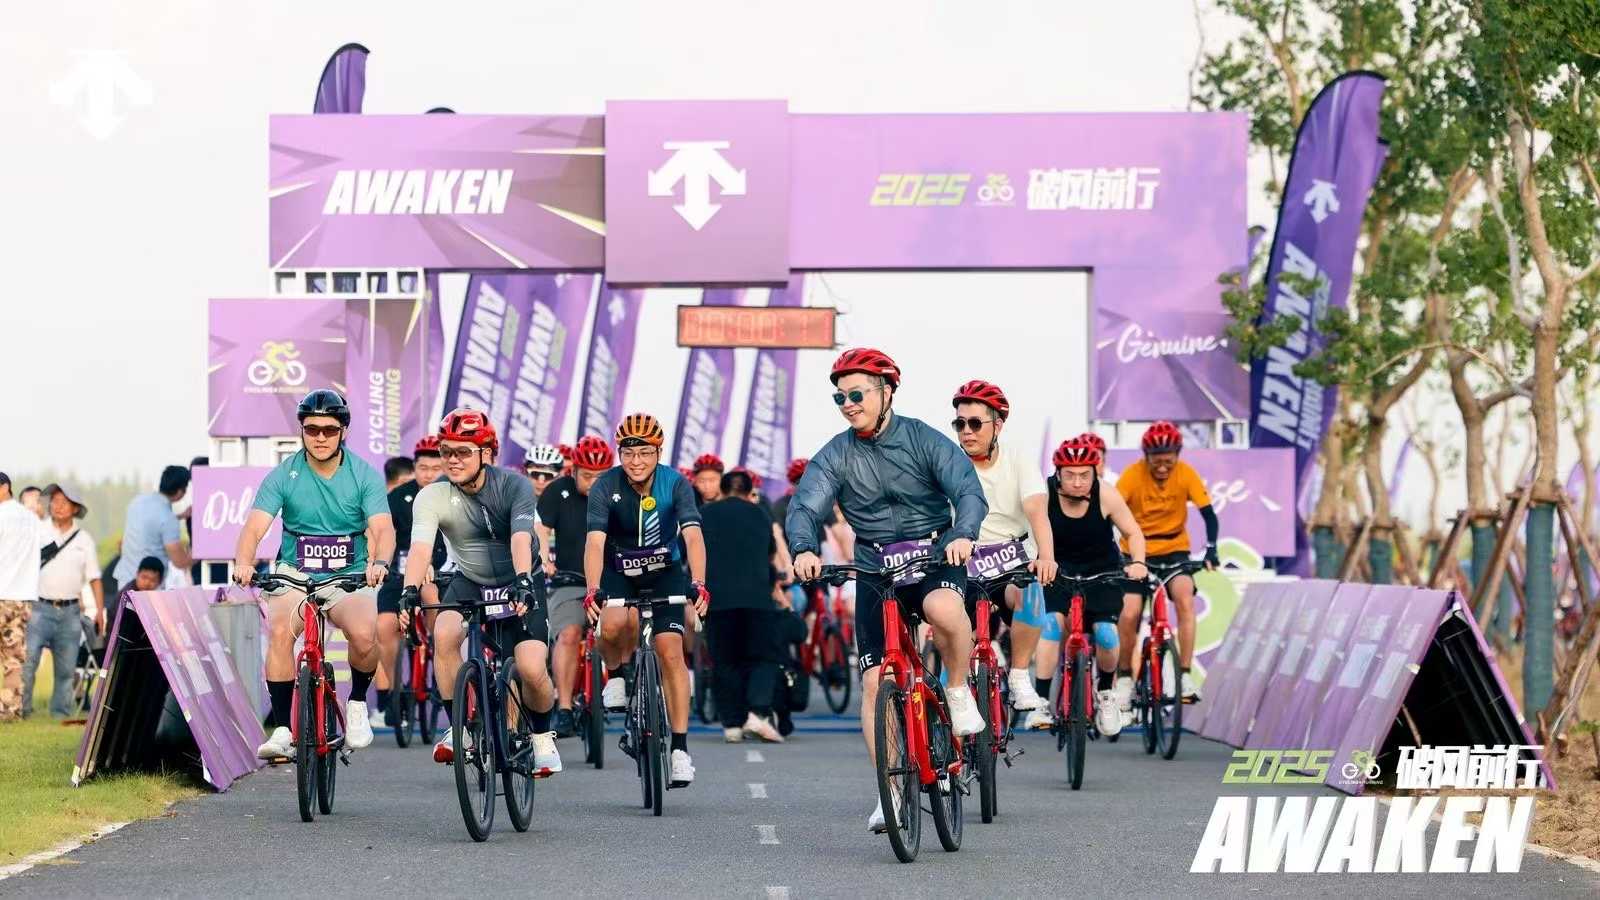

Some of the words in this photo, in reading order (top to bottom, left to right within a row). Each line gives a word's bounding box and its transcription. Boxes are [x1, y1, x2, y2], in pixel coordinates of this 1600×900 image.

[322, 169, 514, 215] AWAKEN
[869, 173, 971, 206] 2025
[1026, 167, 1161, 211] 破风前行
[1116, 323, 1217, 363] Genuine
[507, 299, 557, 450] AWAKEN
[368, 370, 385, 455] CYCLING
[304, 544, 347, 557] D0308
[622, 554, 665, 569] D0309
[974, 544, 1018, 574] D0109
